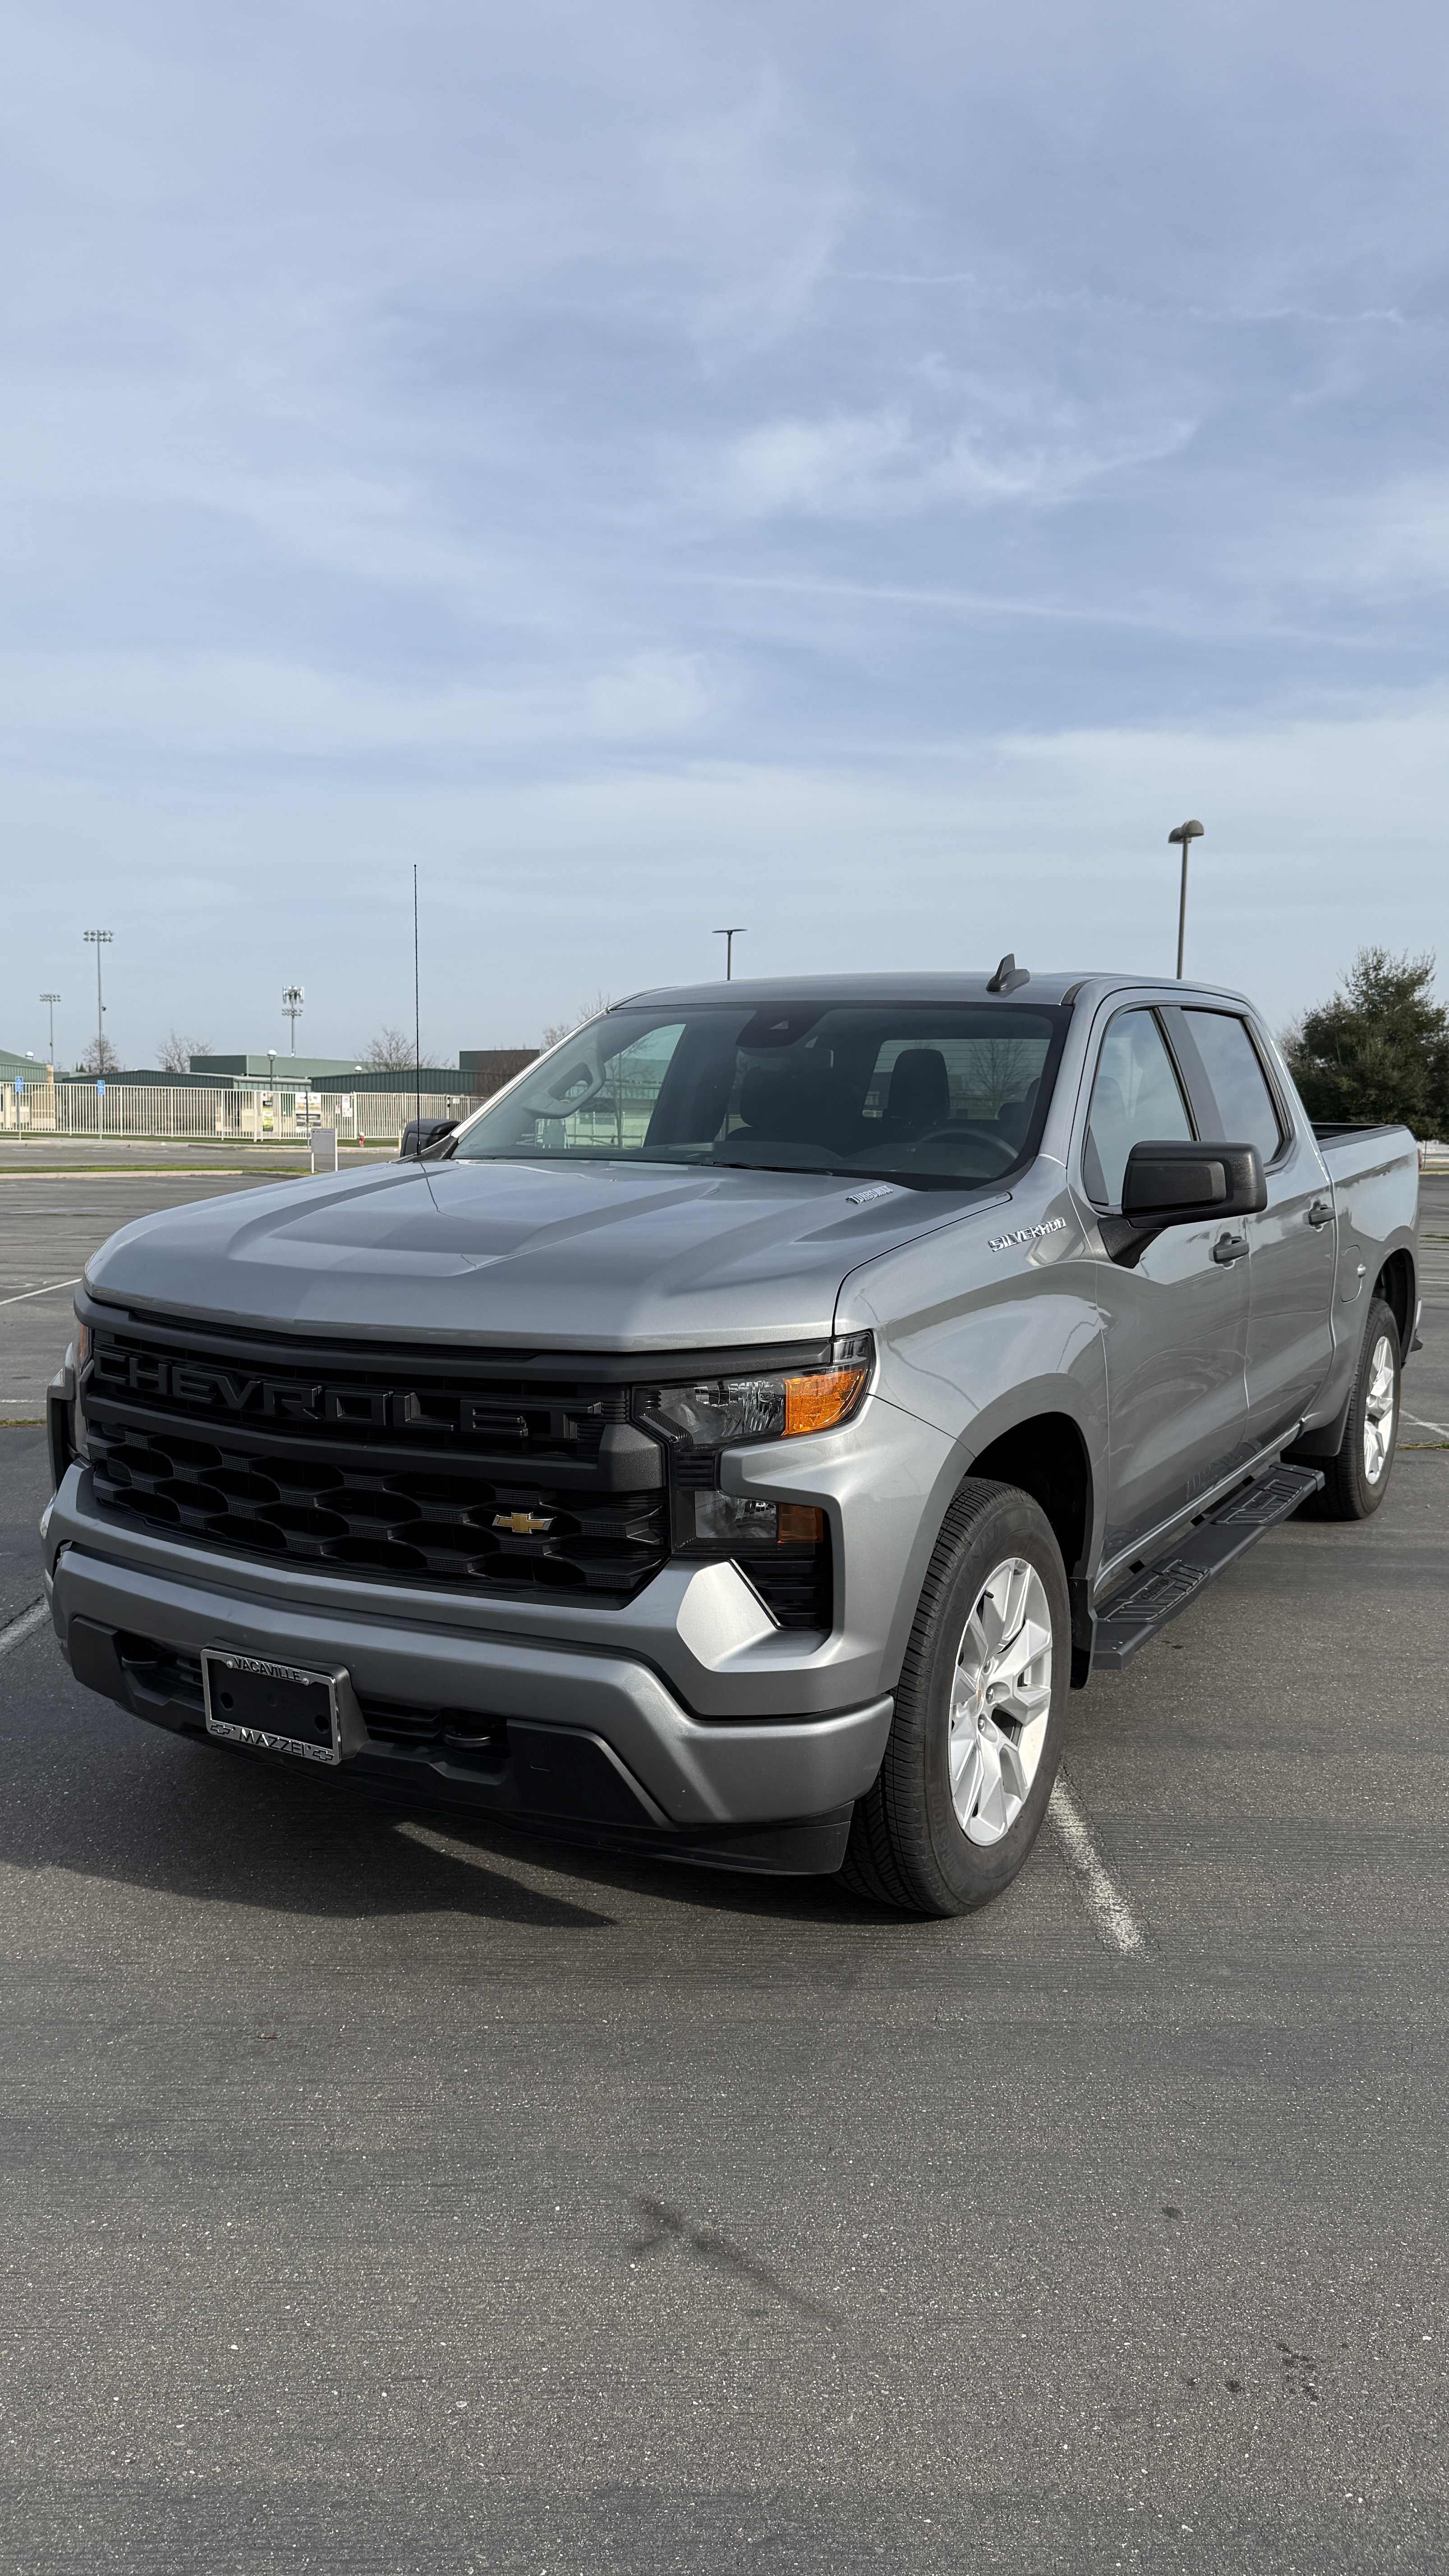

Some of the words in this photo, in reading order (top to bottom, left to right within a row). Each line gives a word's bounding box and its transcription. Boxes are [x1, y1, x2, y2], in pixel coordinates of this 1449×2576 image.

[846, 1185, 893, 1205] TURBOMAX
[988, 1217, 1067, 1252] SILVERADO
[94, 1345, 603, 1440] CHEVROLET
[233, 1656, 302, 1682] VACAVILLE
[239, 1729, 306, 1757] MAZZEI
